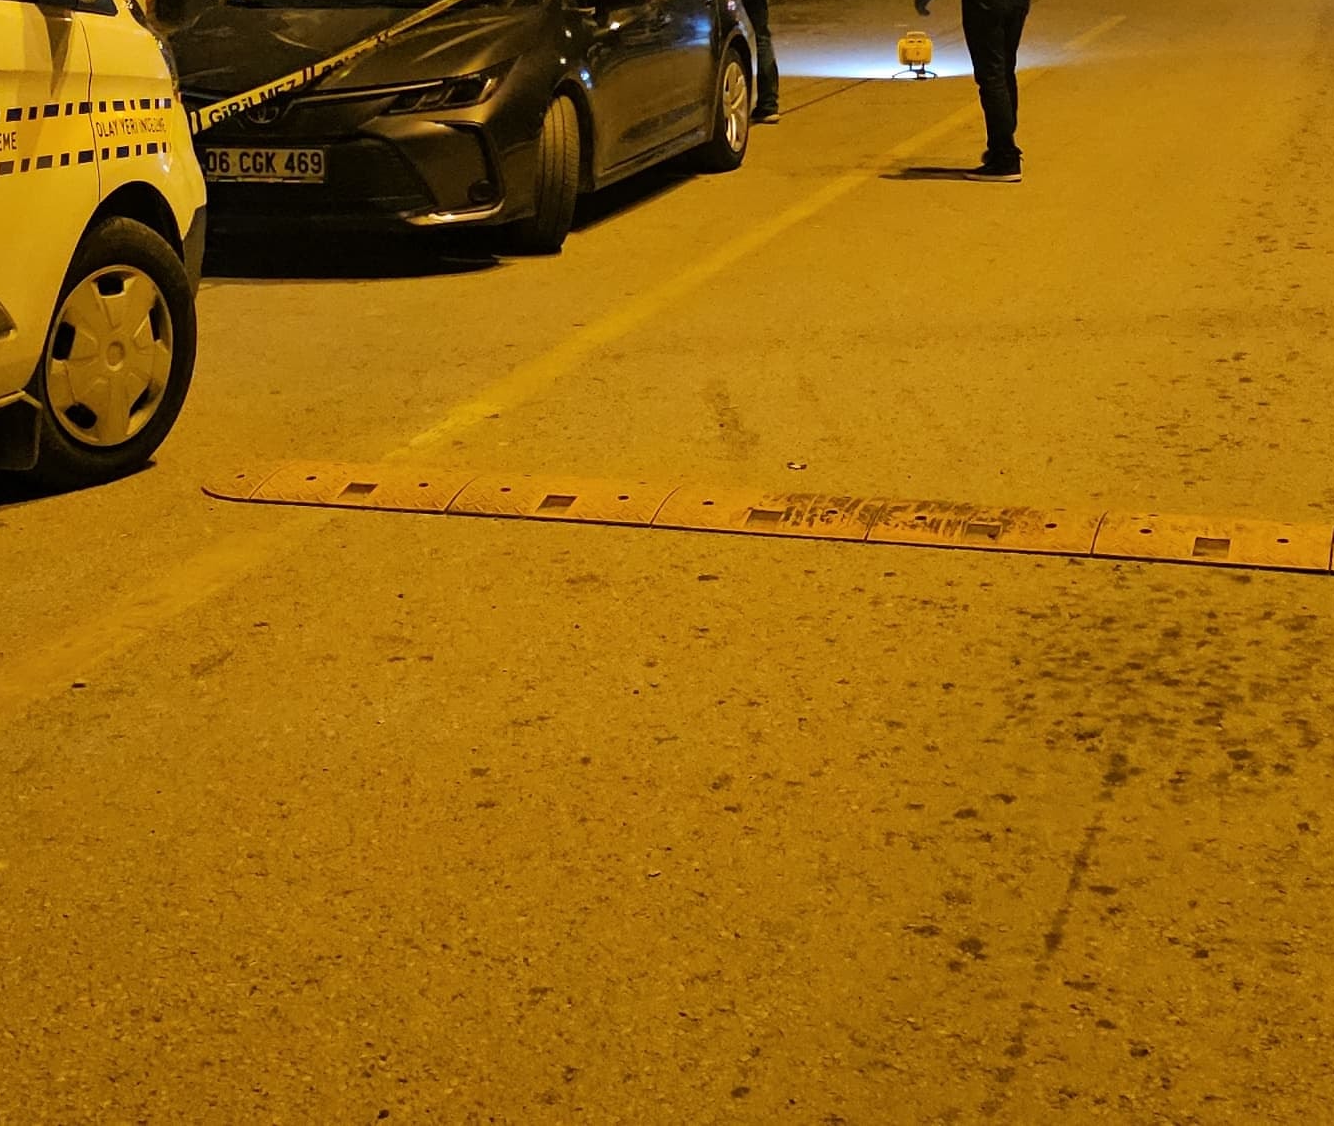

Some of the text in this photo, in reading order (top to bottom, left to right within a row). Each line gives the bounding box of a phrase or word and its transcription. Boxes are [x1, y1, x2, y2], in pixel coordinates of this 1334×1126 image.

[96, 120, 119, 137] OLAY
[207, 151, 323, 174] 06 CGK 469
